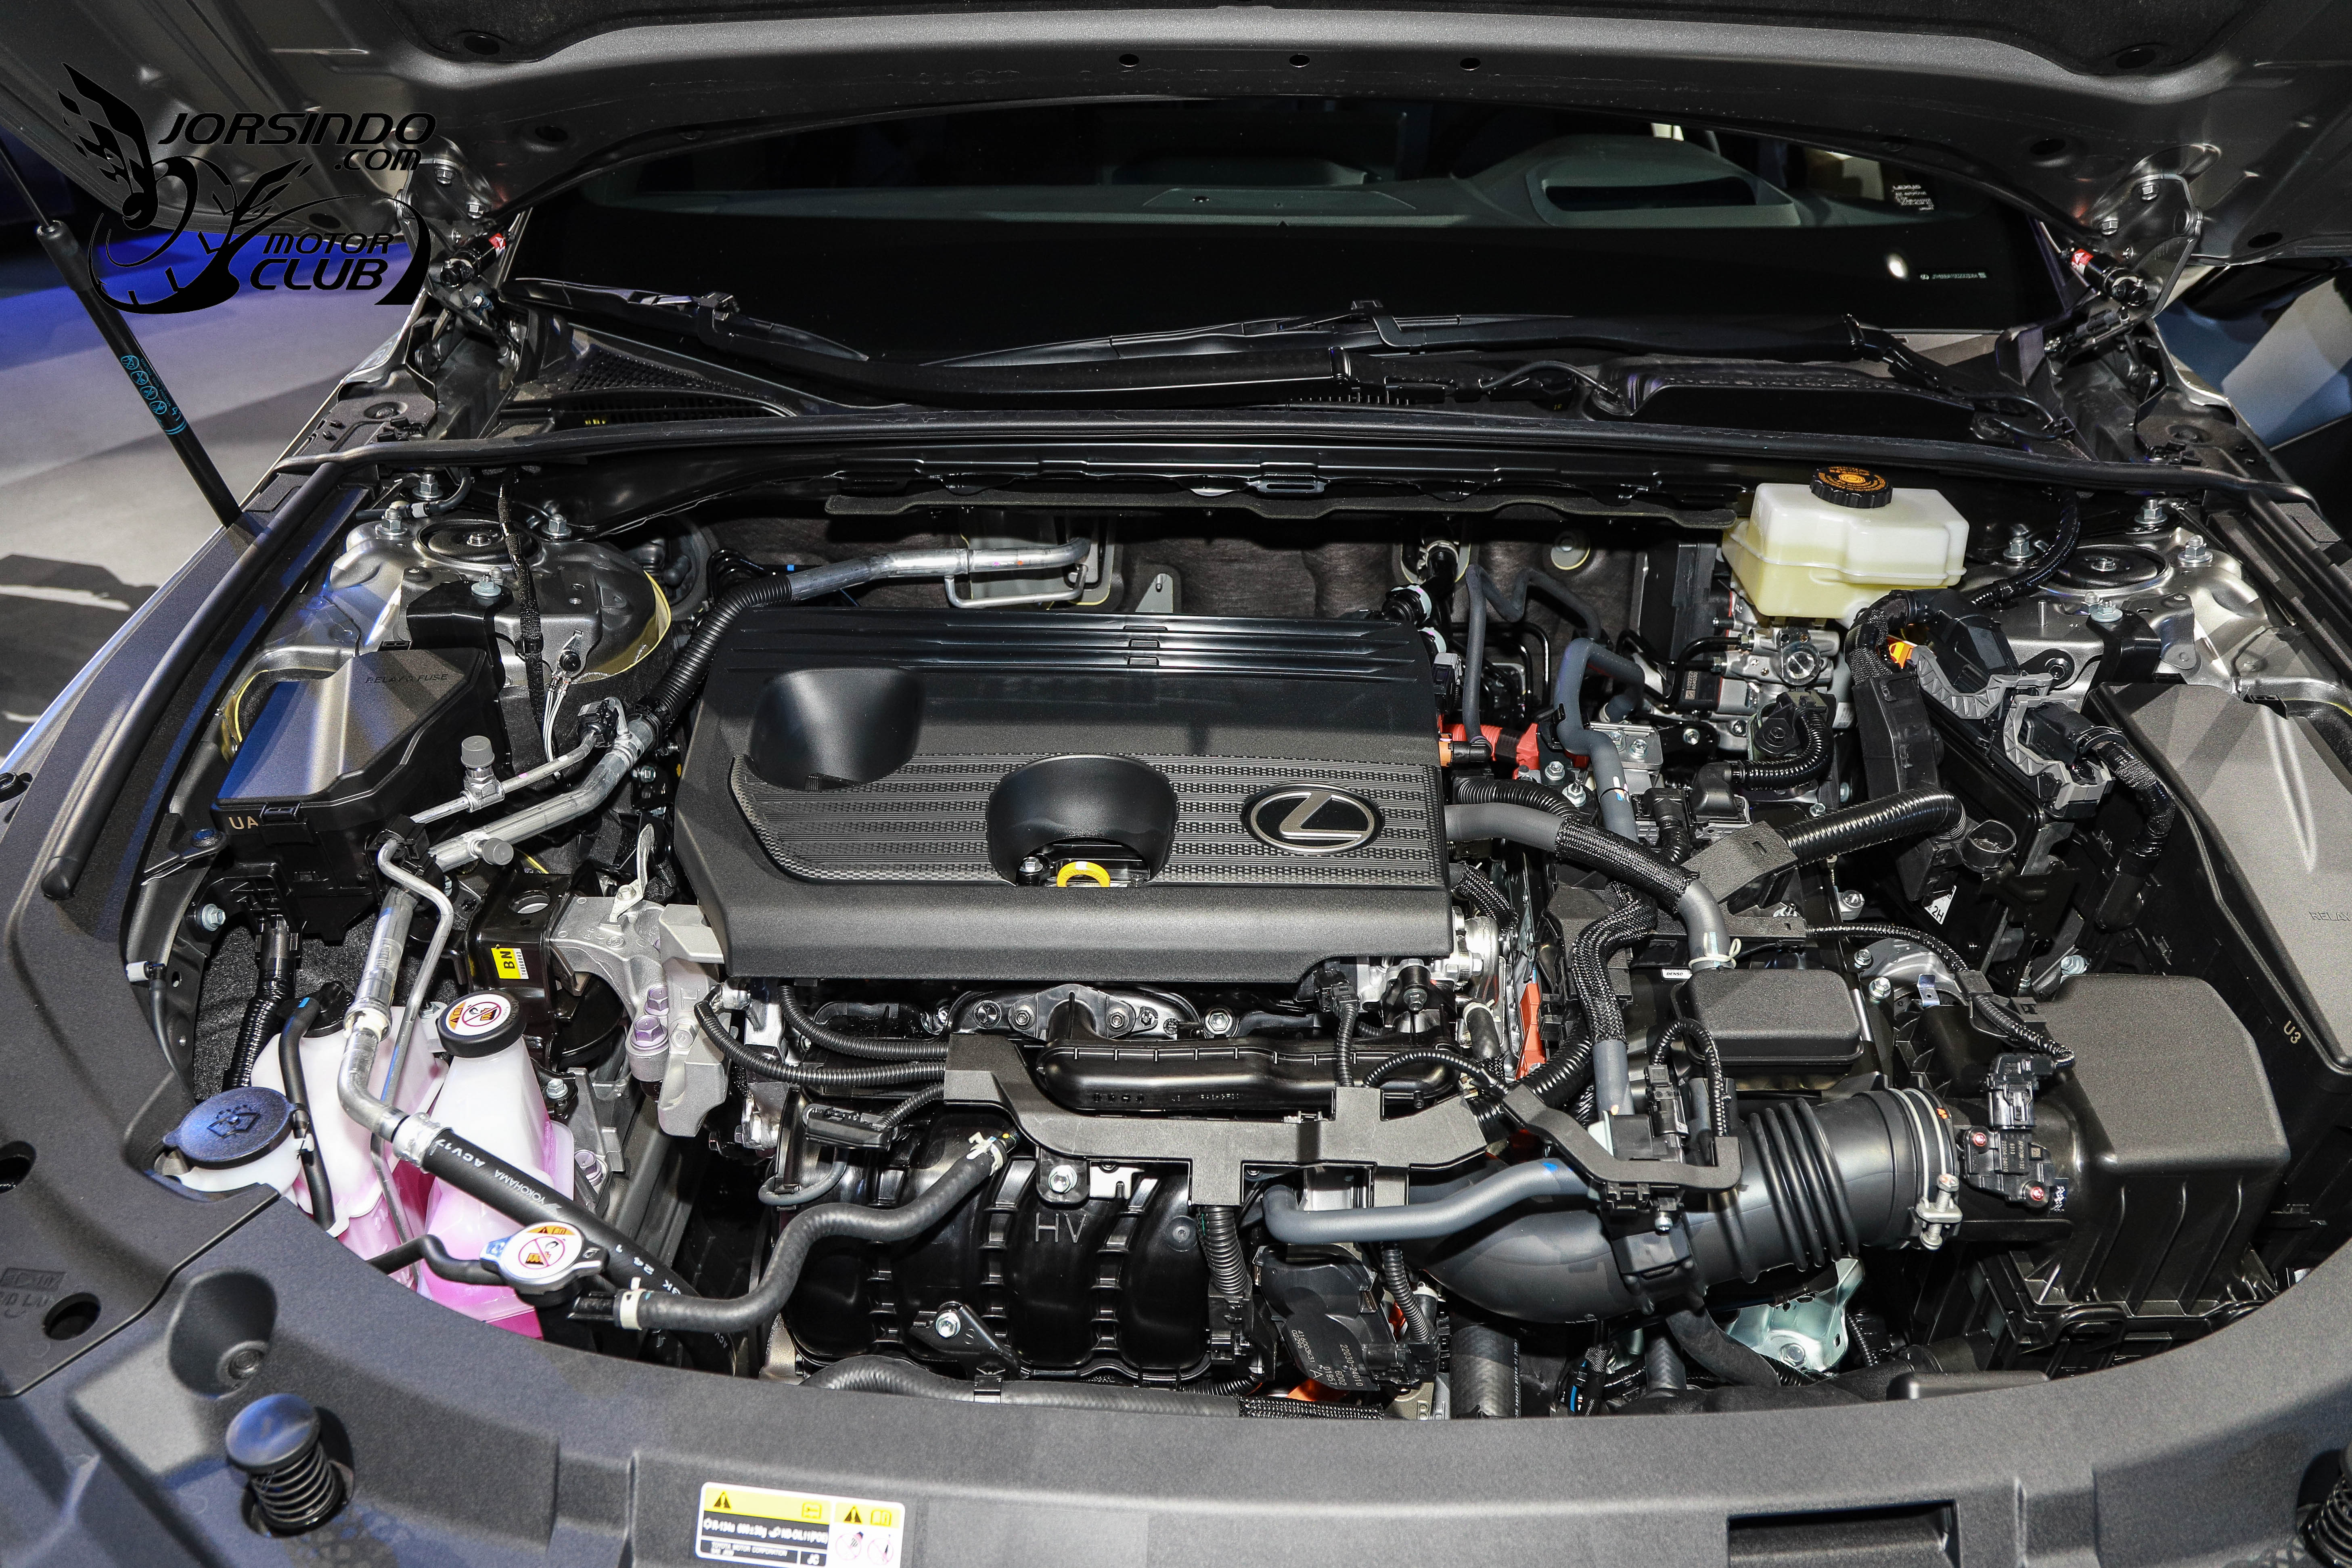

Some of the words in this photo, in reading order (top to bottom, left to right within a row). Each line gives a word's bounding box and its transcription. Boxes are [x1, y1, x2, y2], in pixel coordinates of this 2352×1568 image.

[417, 674, 448, 682] FUSE
[228, 816, 259, 829] UA
[1931, 905, 1944, 922] 2H
[2308, 911, 2351, 921] RELAY
[500, 951, 516, 969] BN
[2284, 1020, 2301, 1044] U3
[435, 1139, 486, 1168] ACV17
[494, 1169, 546, 1206] YOKOHAMA
[1035, 1212, 1087, 1243] HV
[633, 1256, 655, 1275] 24
[1291, 1330, 1304, 1349] 02296
[1309, 1369, 1323, 1379] A
[1340, 1344, 1364, 1386] 22030-24010
[1324, 1366, 1338, 1386] 01957
[1335, 1370, 1347, 1386] 6D02
[711, 1541, 732, 1550] TOYOTA
[732, 1543, 751, 1553] MOTOR
